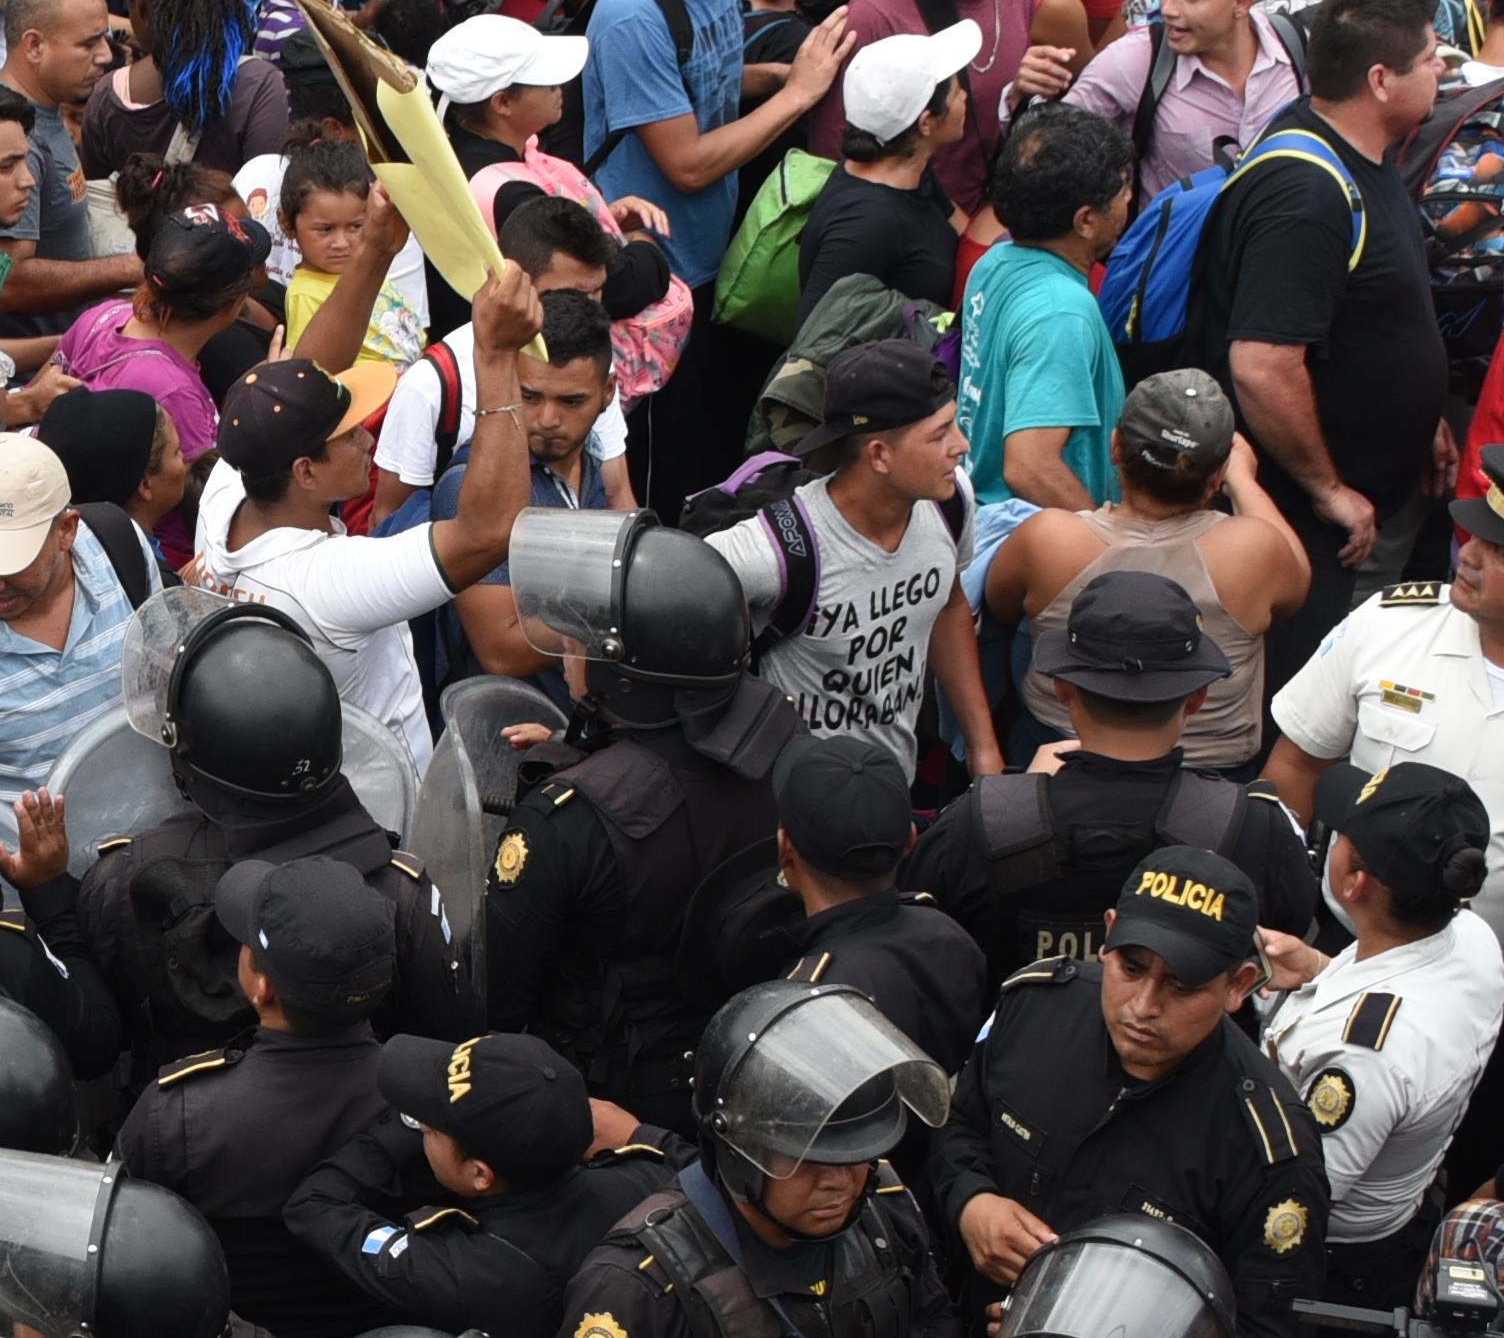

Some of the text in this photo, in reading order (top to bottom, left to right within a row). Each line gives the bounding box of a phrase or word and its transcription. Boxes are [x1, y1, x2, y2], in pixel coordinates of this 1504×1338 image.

[868, 566, 941, 618] LLEGO
[848, 616, 909, 666] POR
[823, 647, 915, 694] QUIEN
[1135, 870, 1225, 922] POLICIA
[448, 1037, 480, 1104] LICIA
